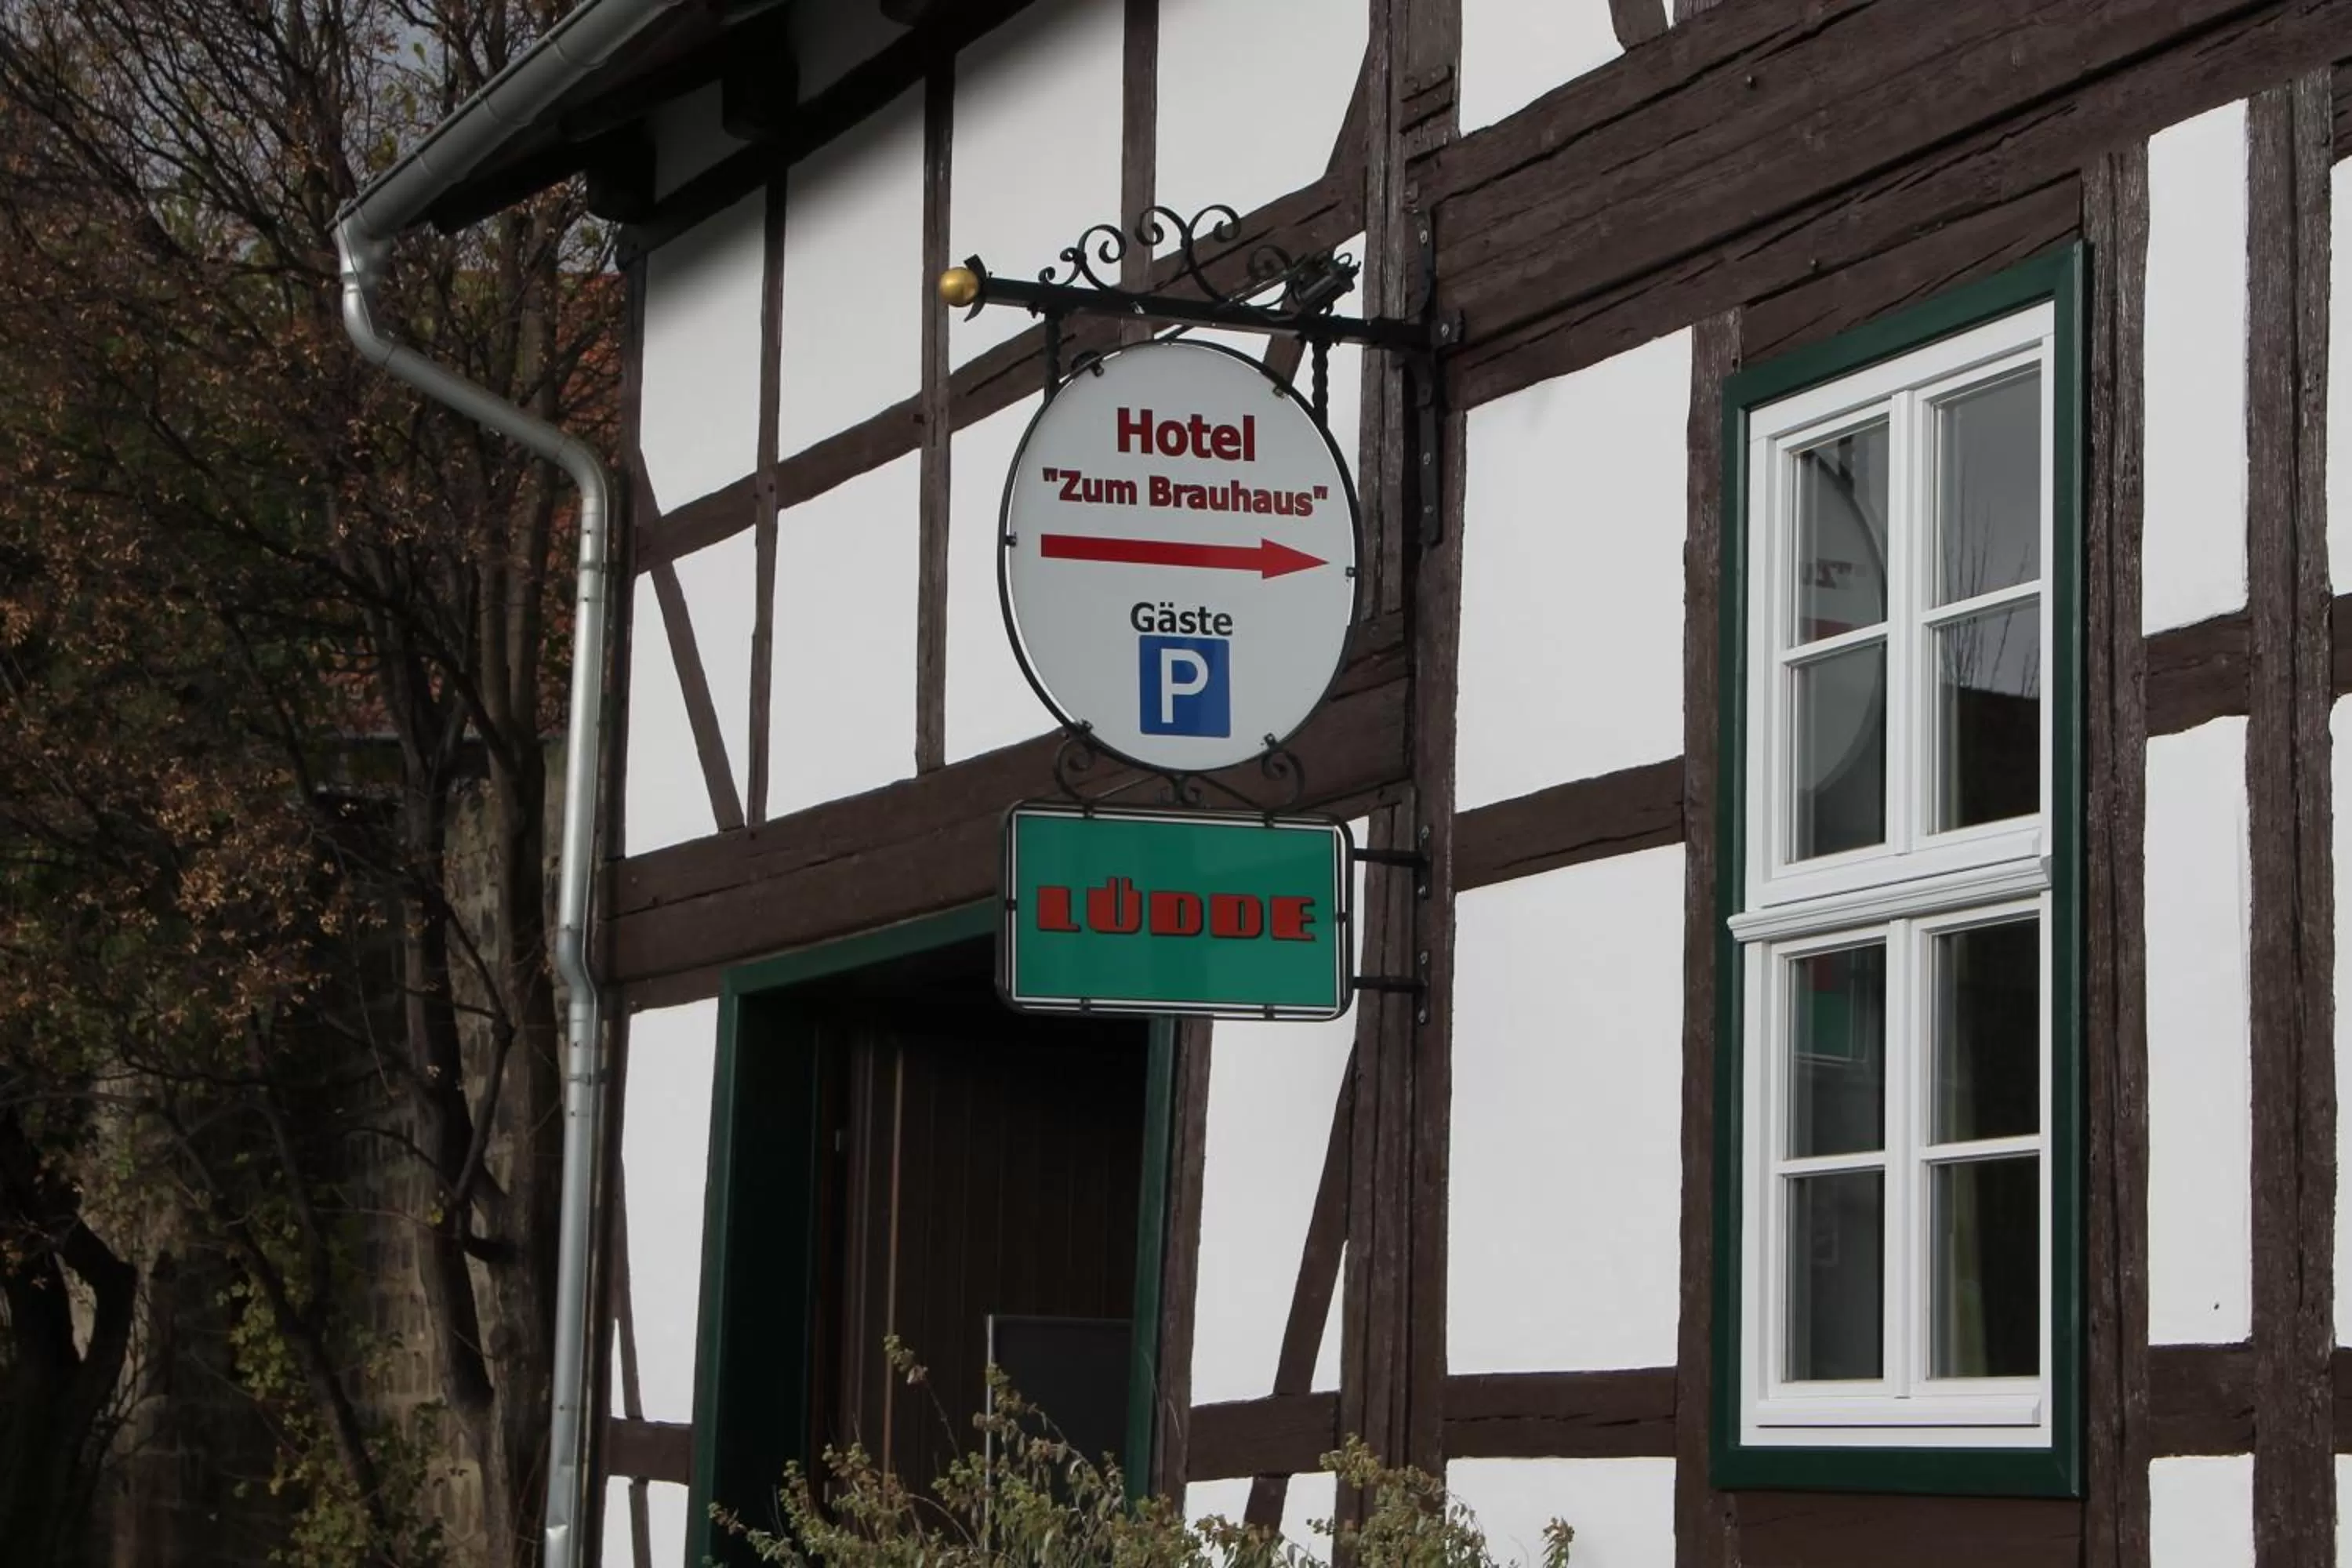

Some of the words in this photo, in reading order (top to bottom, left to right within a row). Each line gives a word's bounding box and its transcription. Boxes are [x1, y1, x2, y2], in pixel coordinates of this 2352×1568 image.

[1117, 407, 1256, 462] Hotel
[1042, 467, 1138, 505] "Zum
[1149, 476, 1328, 517] Brauhaus"
[1130, 601, 1233, 636] Gäste
[1160, 648, 1209, 724] P
[1036, 877, 1316, 941] LÜDDE
